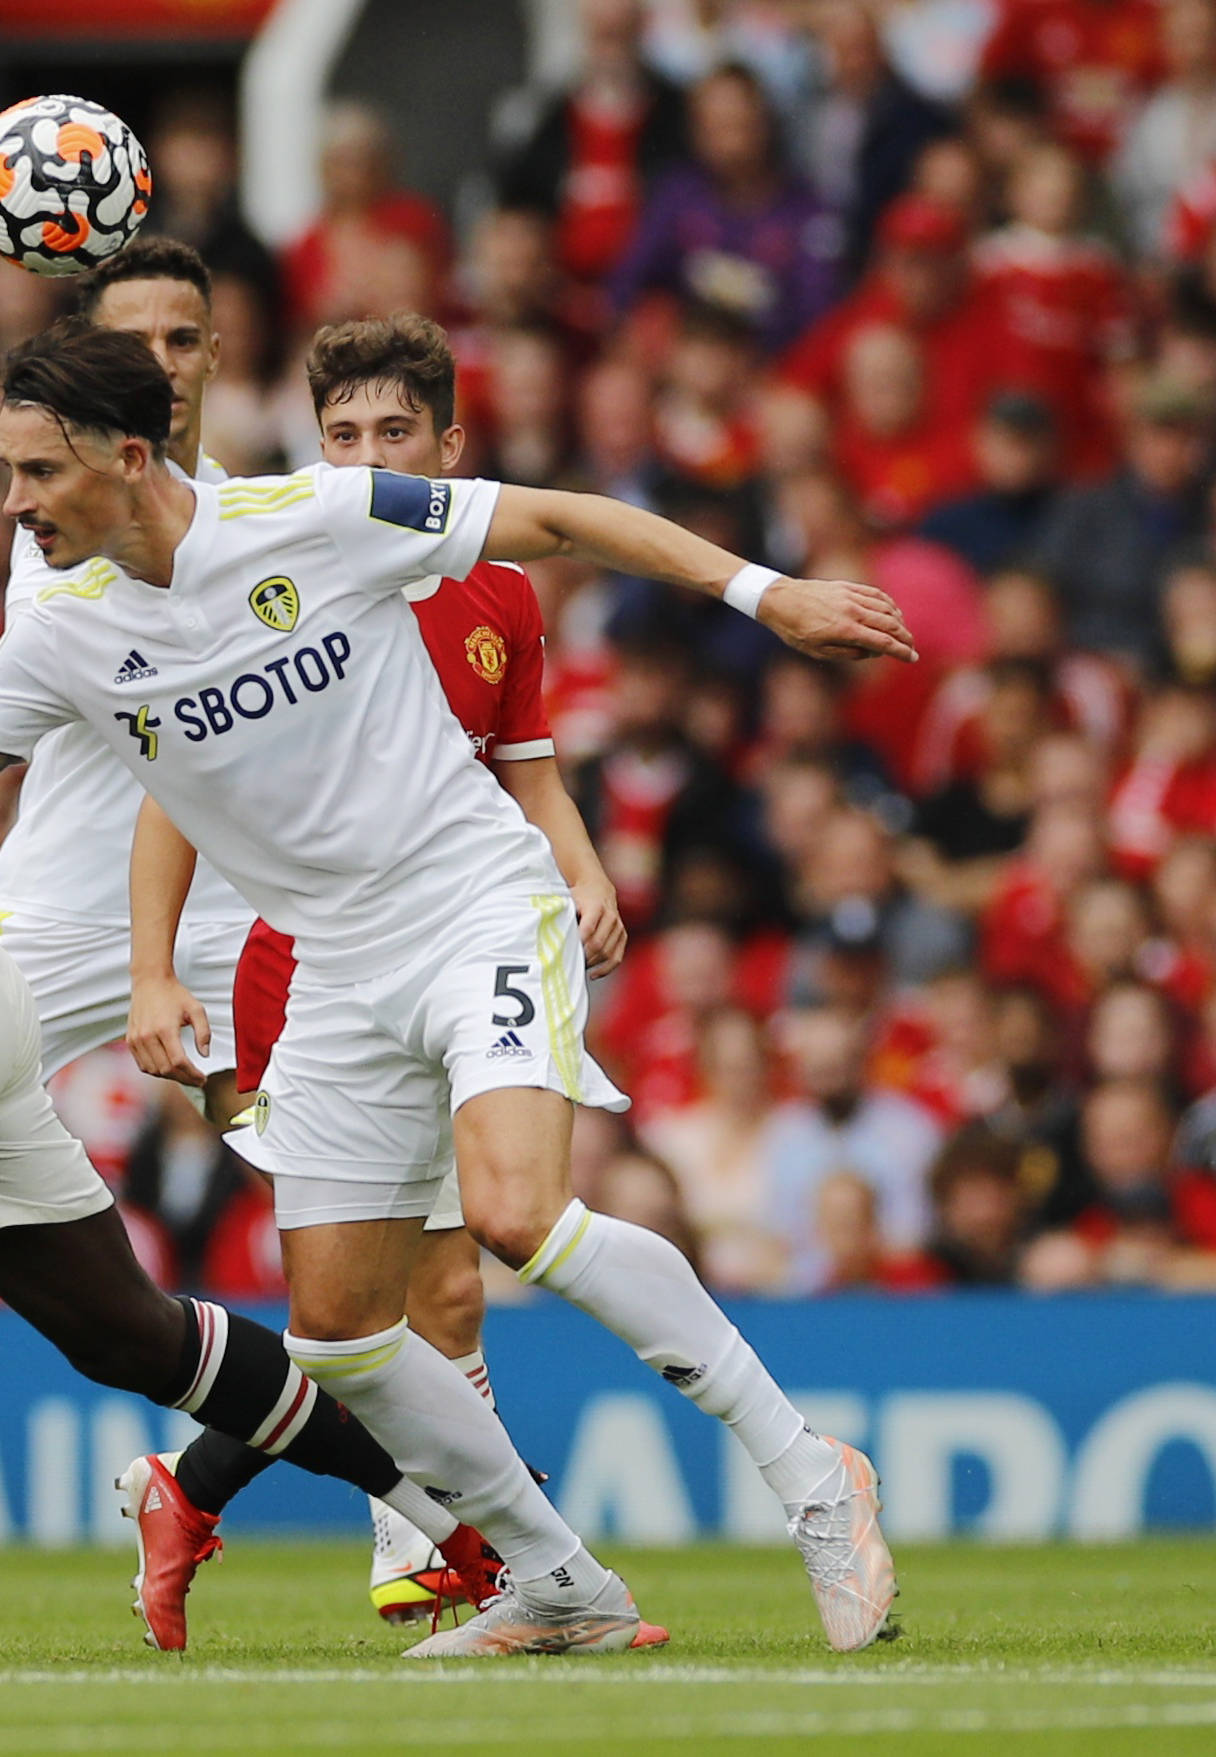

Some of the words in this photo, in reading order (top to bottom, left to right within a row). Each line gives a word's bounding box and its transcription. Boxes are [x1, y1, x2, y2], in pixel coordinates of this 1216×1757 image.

[114, 666, 158, 684] adidas
[174, 631, 351, 742] SBOTOP
[492, 965, 535, 1027] 5
[486, 1045, 533, 1058] adidas
